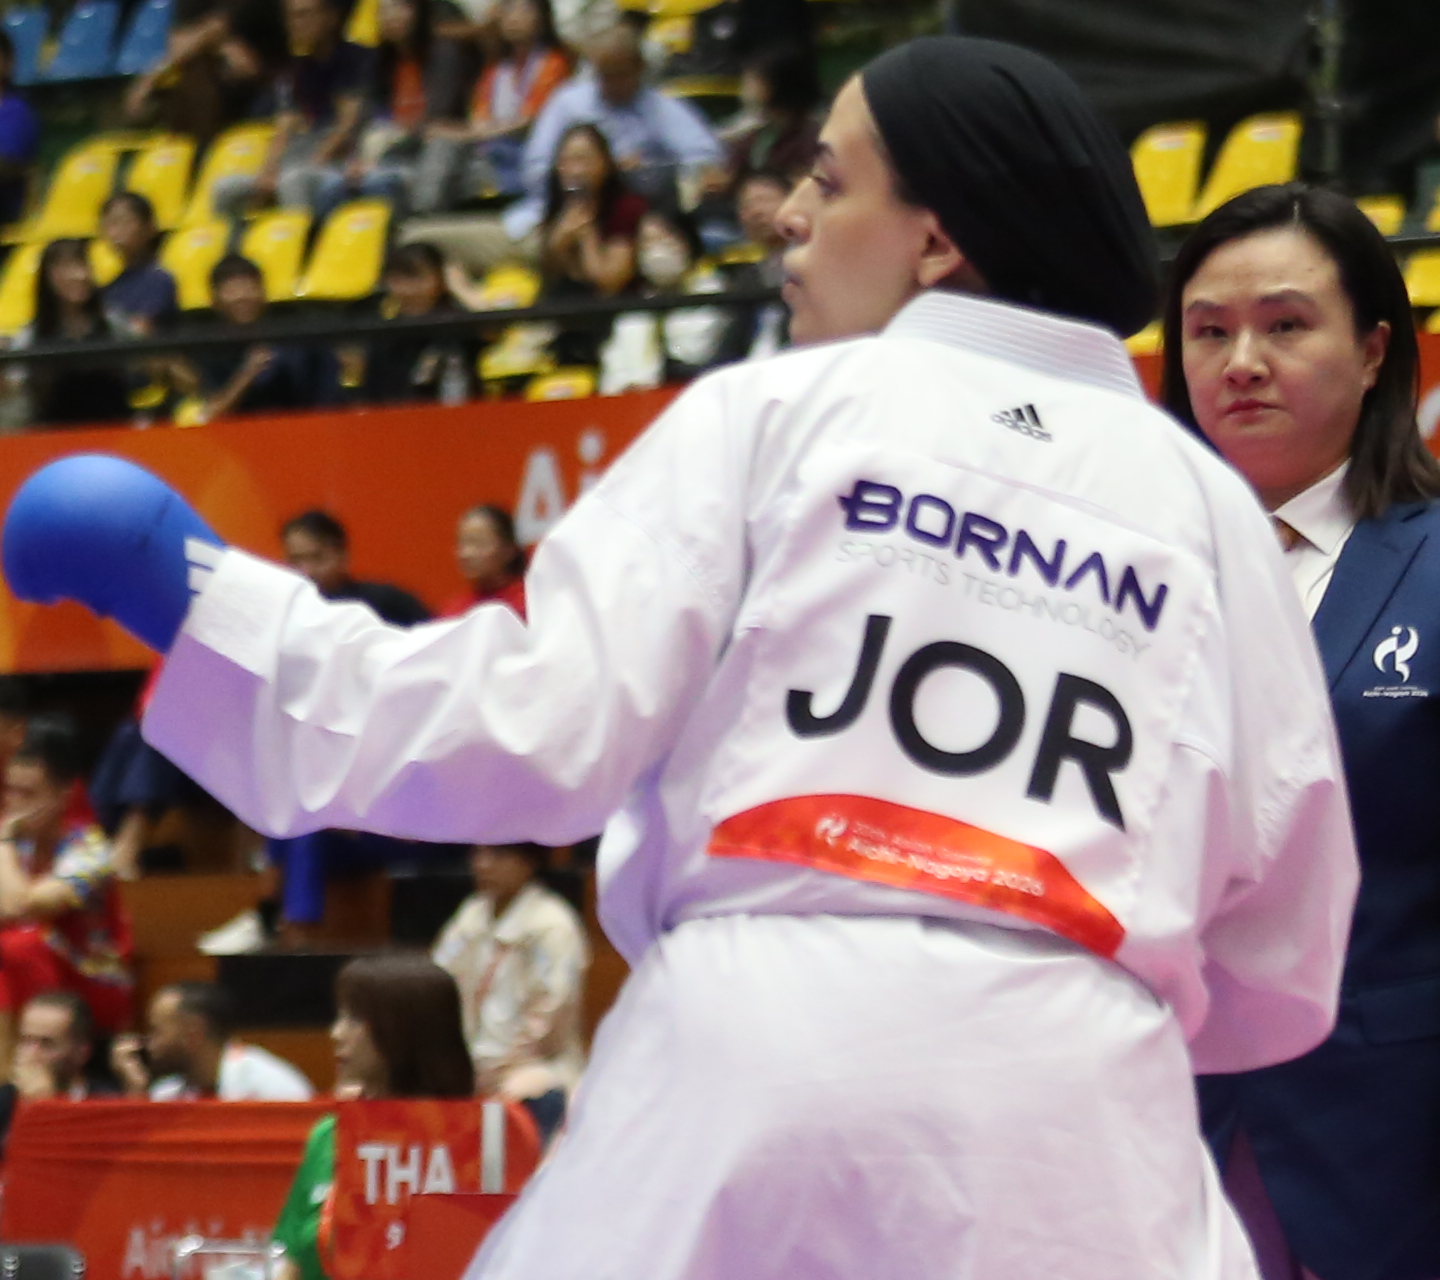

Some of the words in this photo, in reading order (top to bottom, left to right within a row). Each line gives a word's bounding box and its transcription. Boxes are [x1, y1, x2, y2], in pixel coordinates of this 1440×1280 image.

[836, 541, 951, 586] SPORTS
[963, 572, 1152, 662] TECHNOLOGY
[838, 479, 1168, 632] BORNAN
[785, 613, 1135, 832] JOR
[356, 1143, 455, 1205] THA
